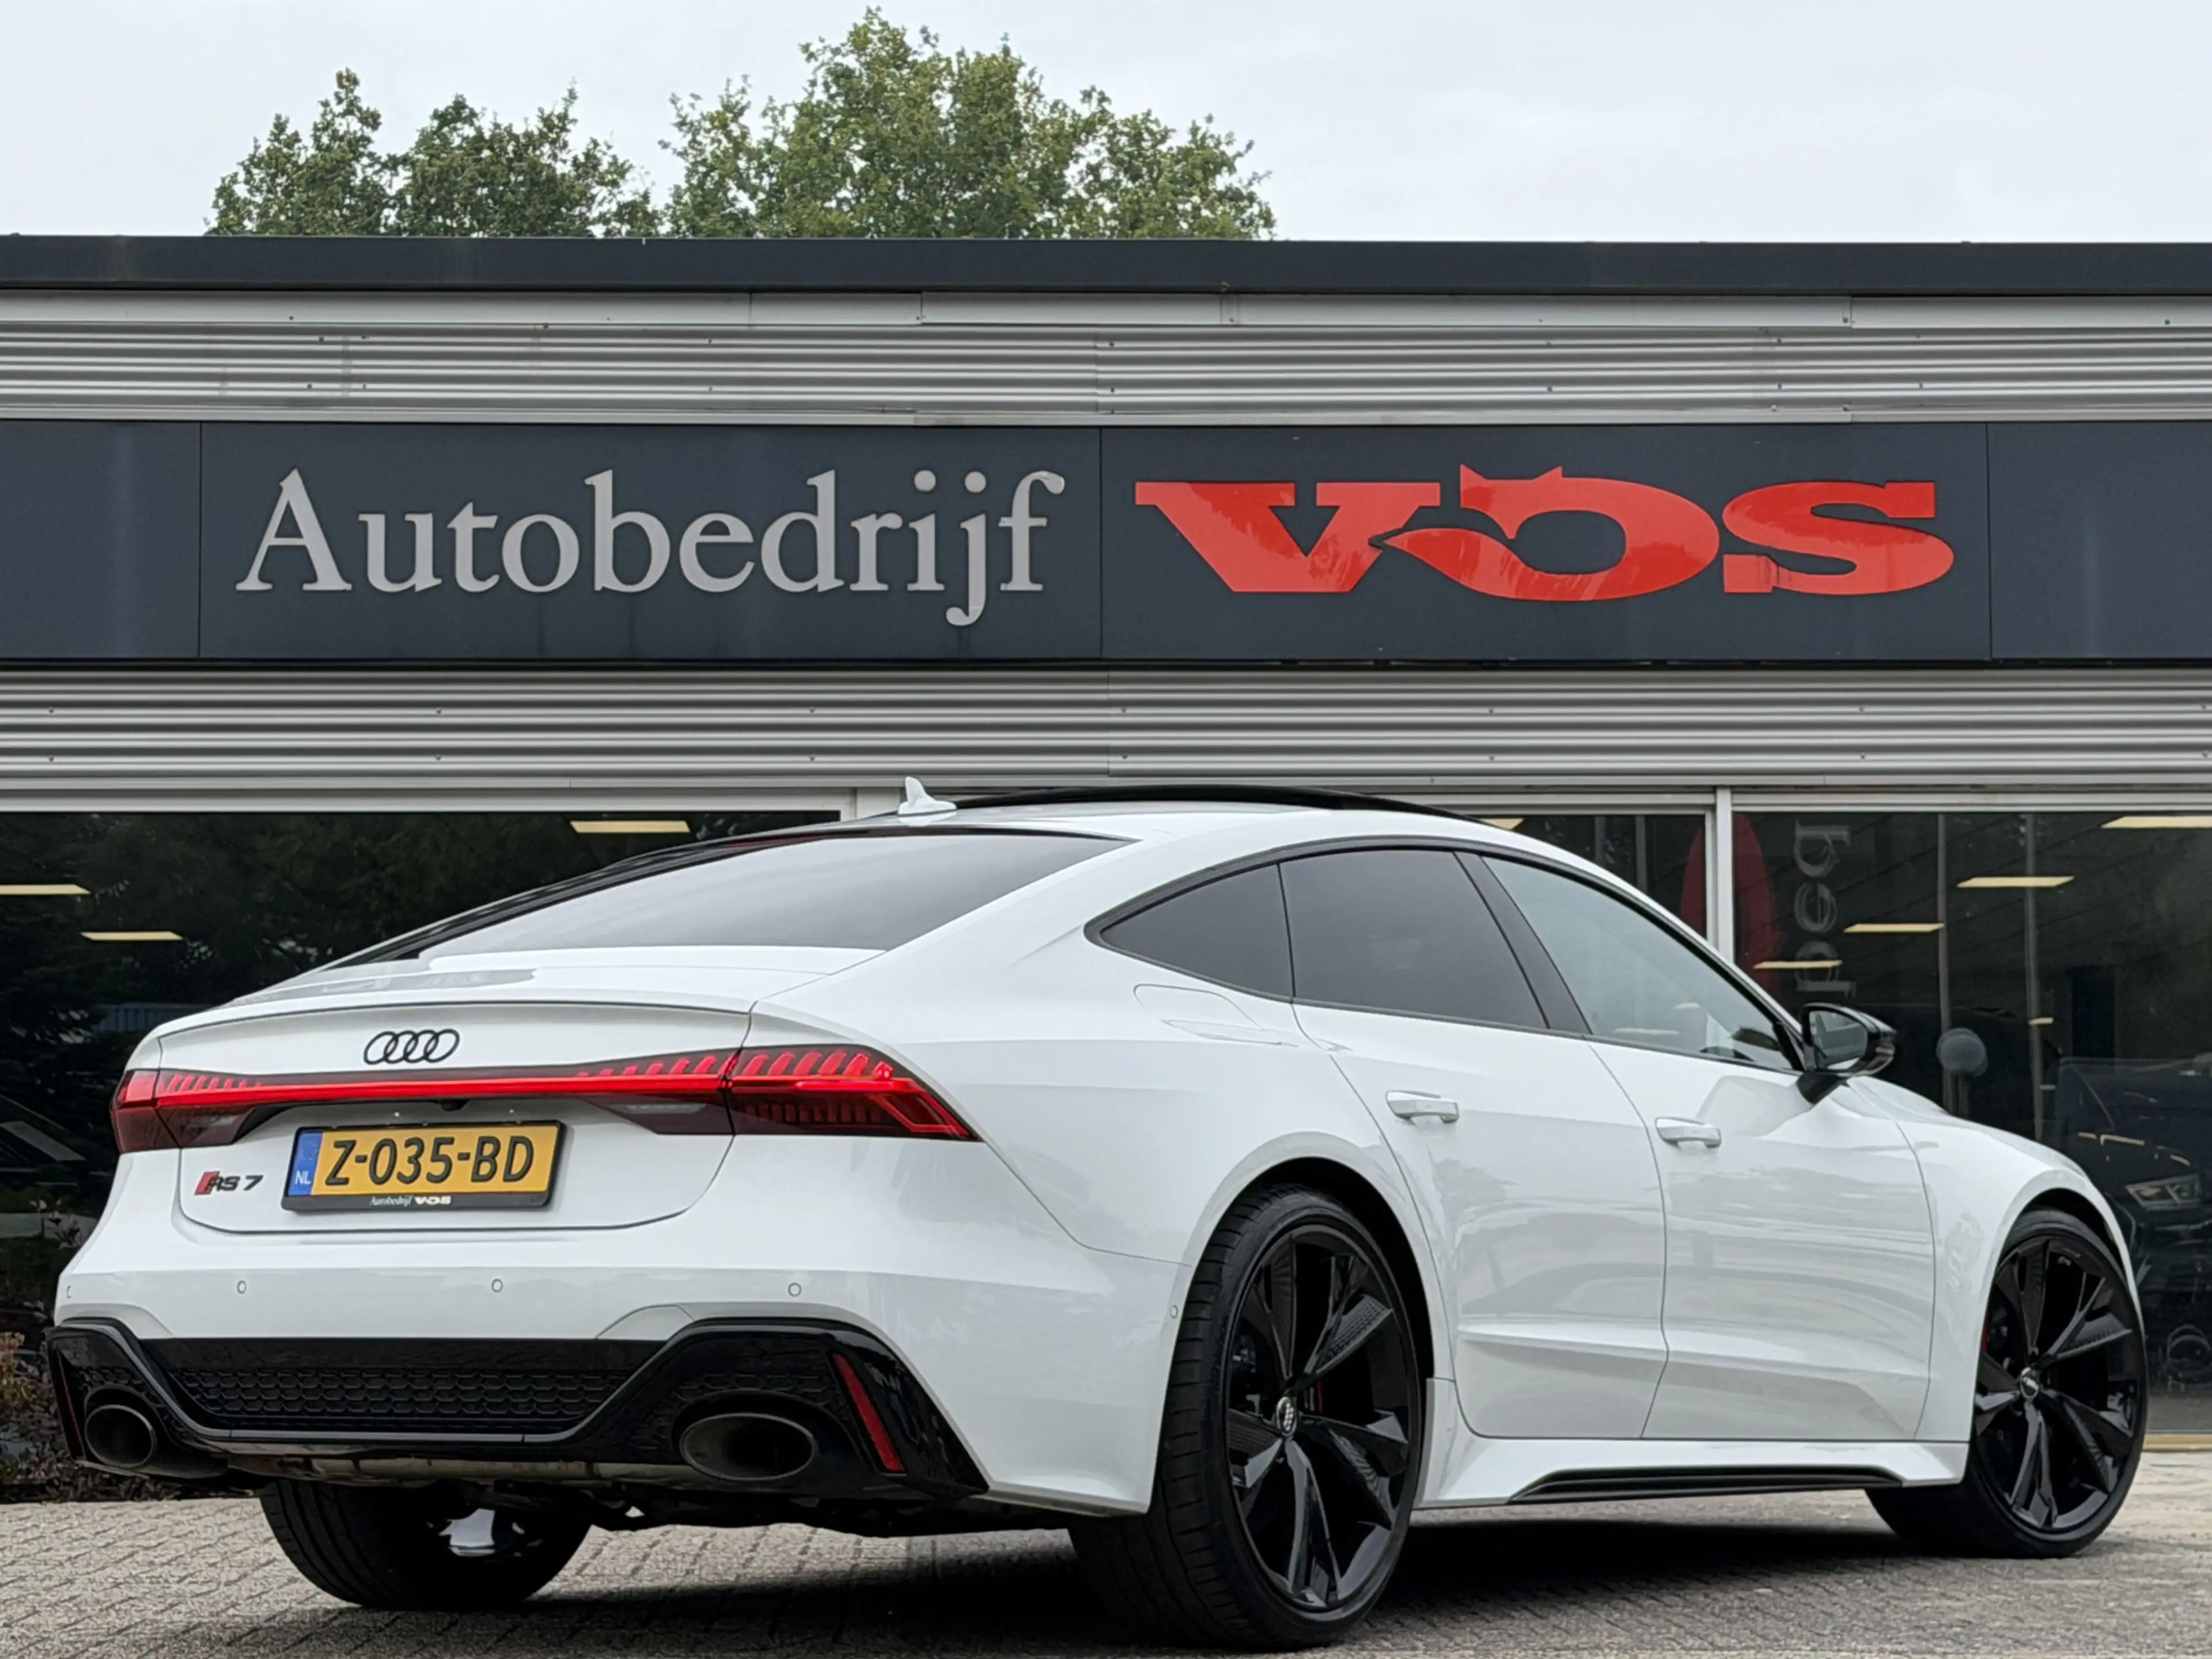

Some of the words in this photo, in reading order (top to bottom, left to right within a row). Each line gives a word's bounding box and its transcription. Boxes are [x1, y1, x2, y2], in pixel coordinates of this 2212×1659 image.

[236, 468, 1065, 626] Autobedrijf
[1135, 464, 1954, 601] VOS
[325, 1135, 535, 1186] Z-035-BD
[295, 1170, 312, 1185] NL
[415, 1195, 451, 1205] VOS
